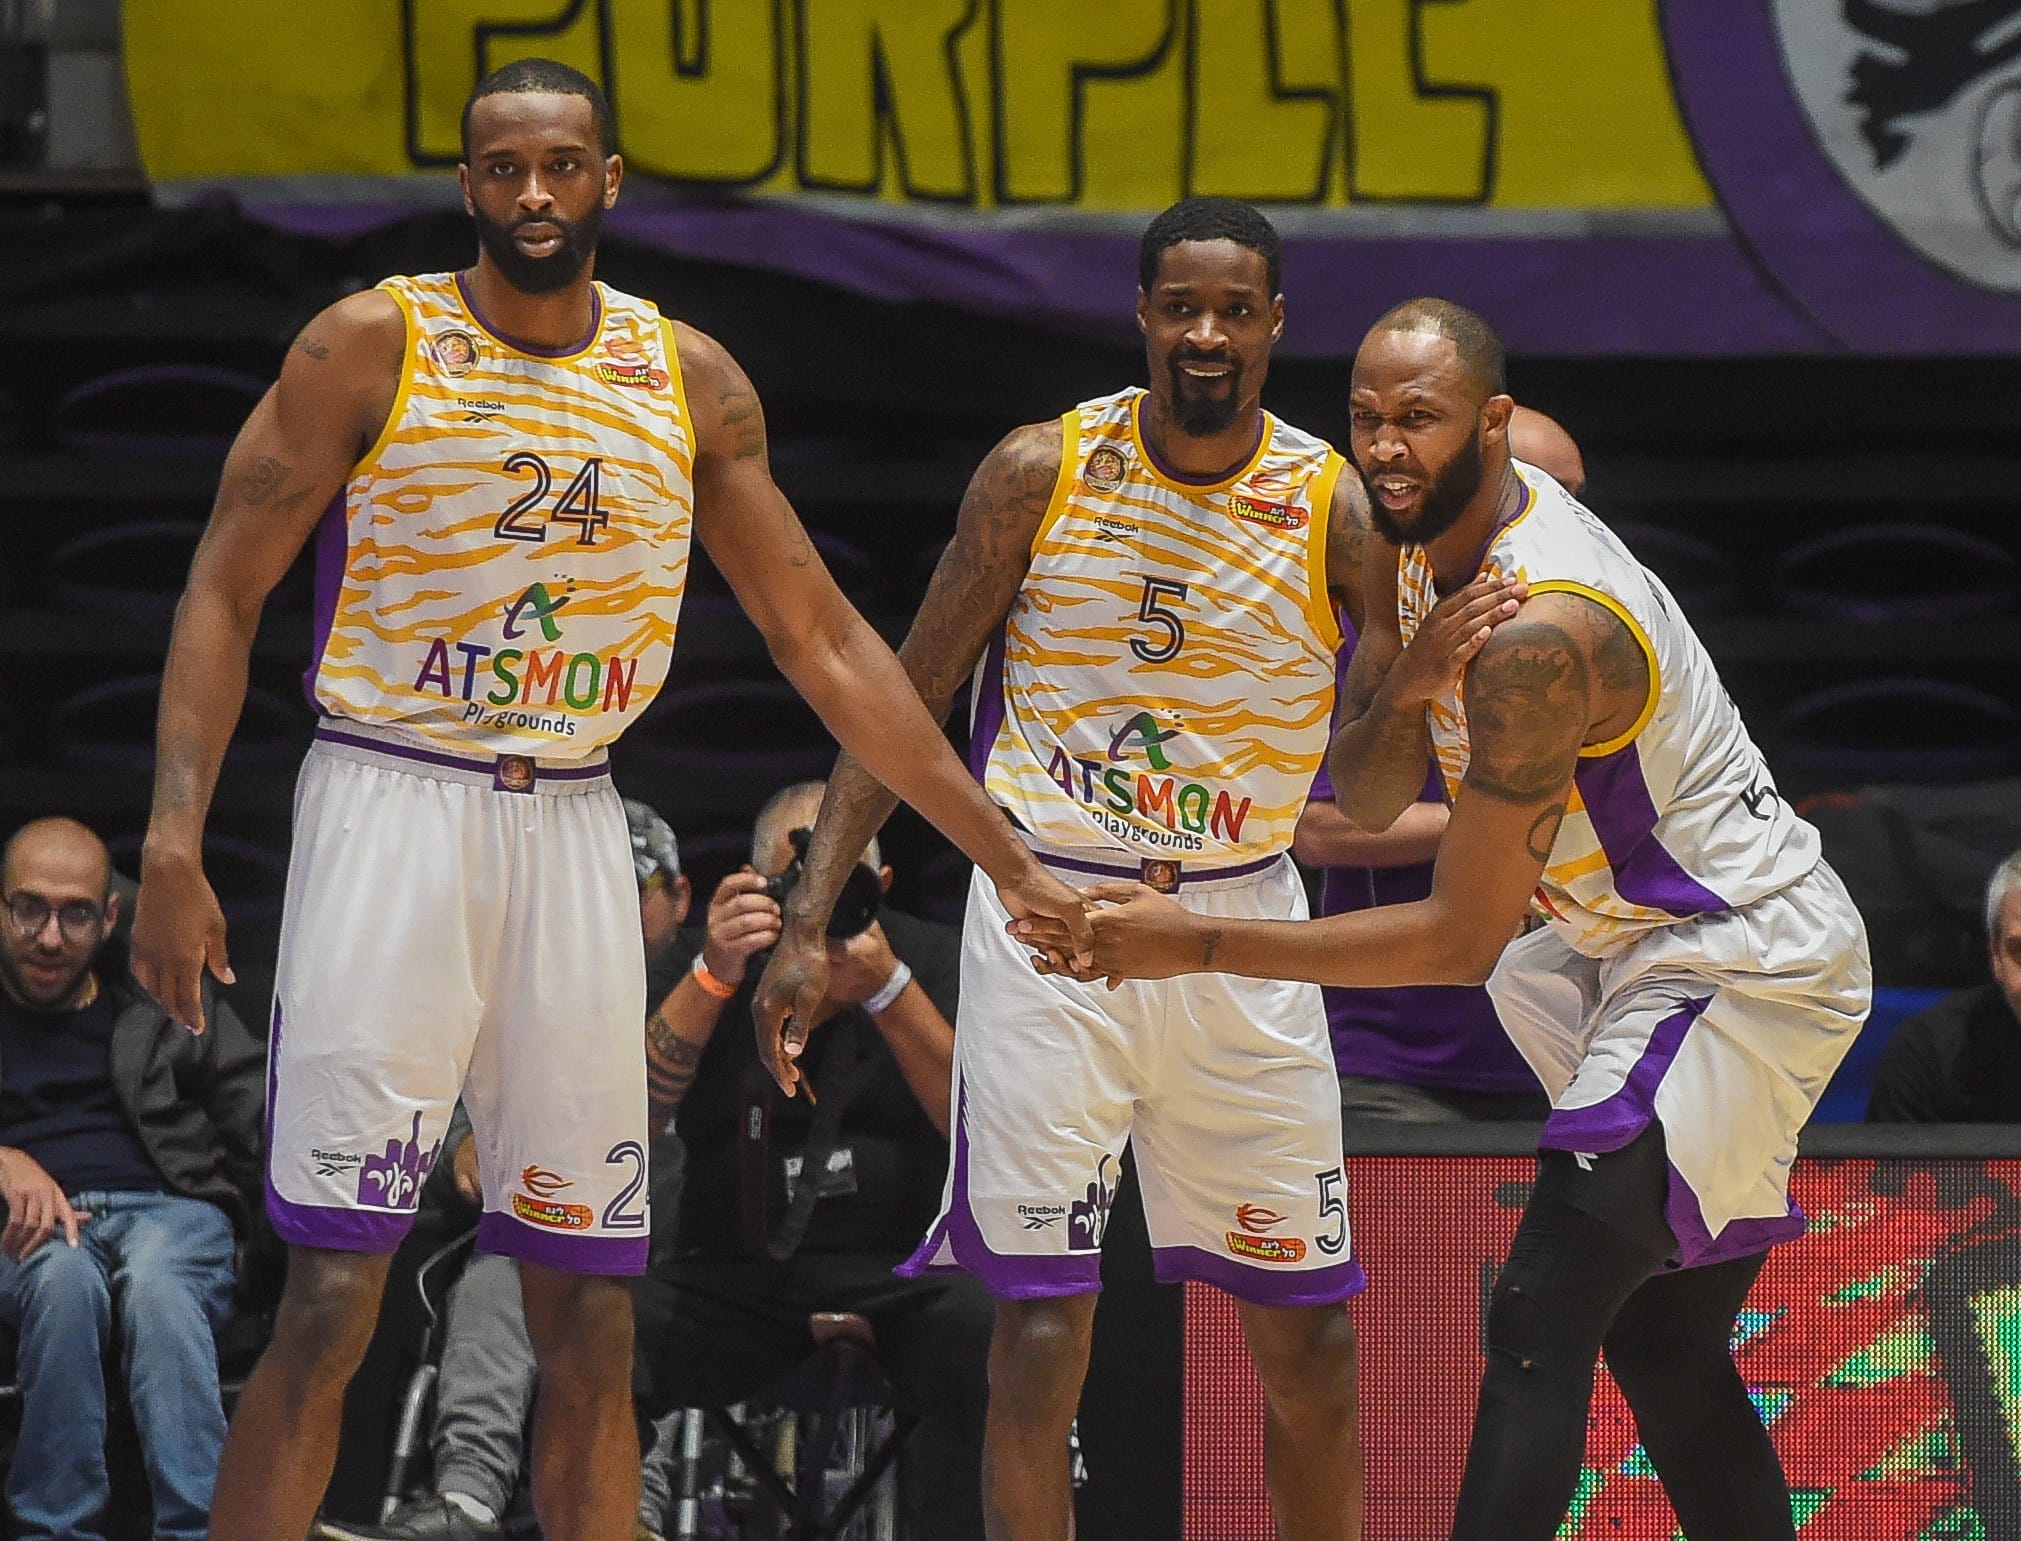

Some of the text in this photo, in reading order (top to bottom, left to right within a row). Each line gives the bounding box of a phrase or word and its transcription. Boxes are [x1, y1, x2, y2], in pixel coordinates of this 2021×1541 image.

[457, 397, 505, 411] Reebok
[493, 451, 609, 545] 24
[1235, 501, 1285, 524] Winner
[1093, 516, 1140, 534] Reebok
[1129, 574, 1189, 665] 5
[413, 636, 638, 713] ATSMON
[1047, 744, 1252, 843] ATSMON
[311, 1149, 361, 1163] Reebok
[520, 1201, 566, 1223] Winner
[1017, 1204, 1066, 1216] Reebok
[1314, 1166, 1347, 1256] 5
[1233, 1238, 1281, 1257] Winner
